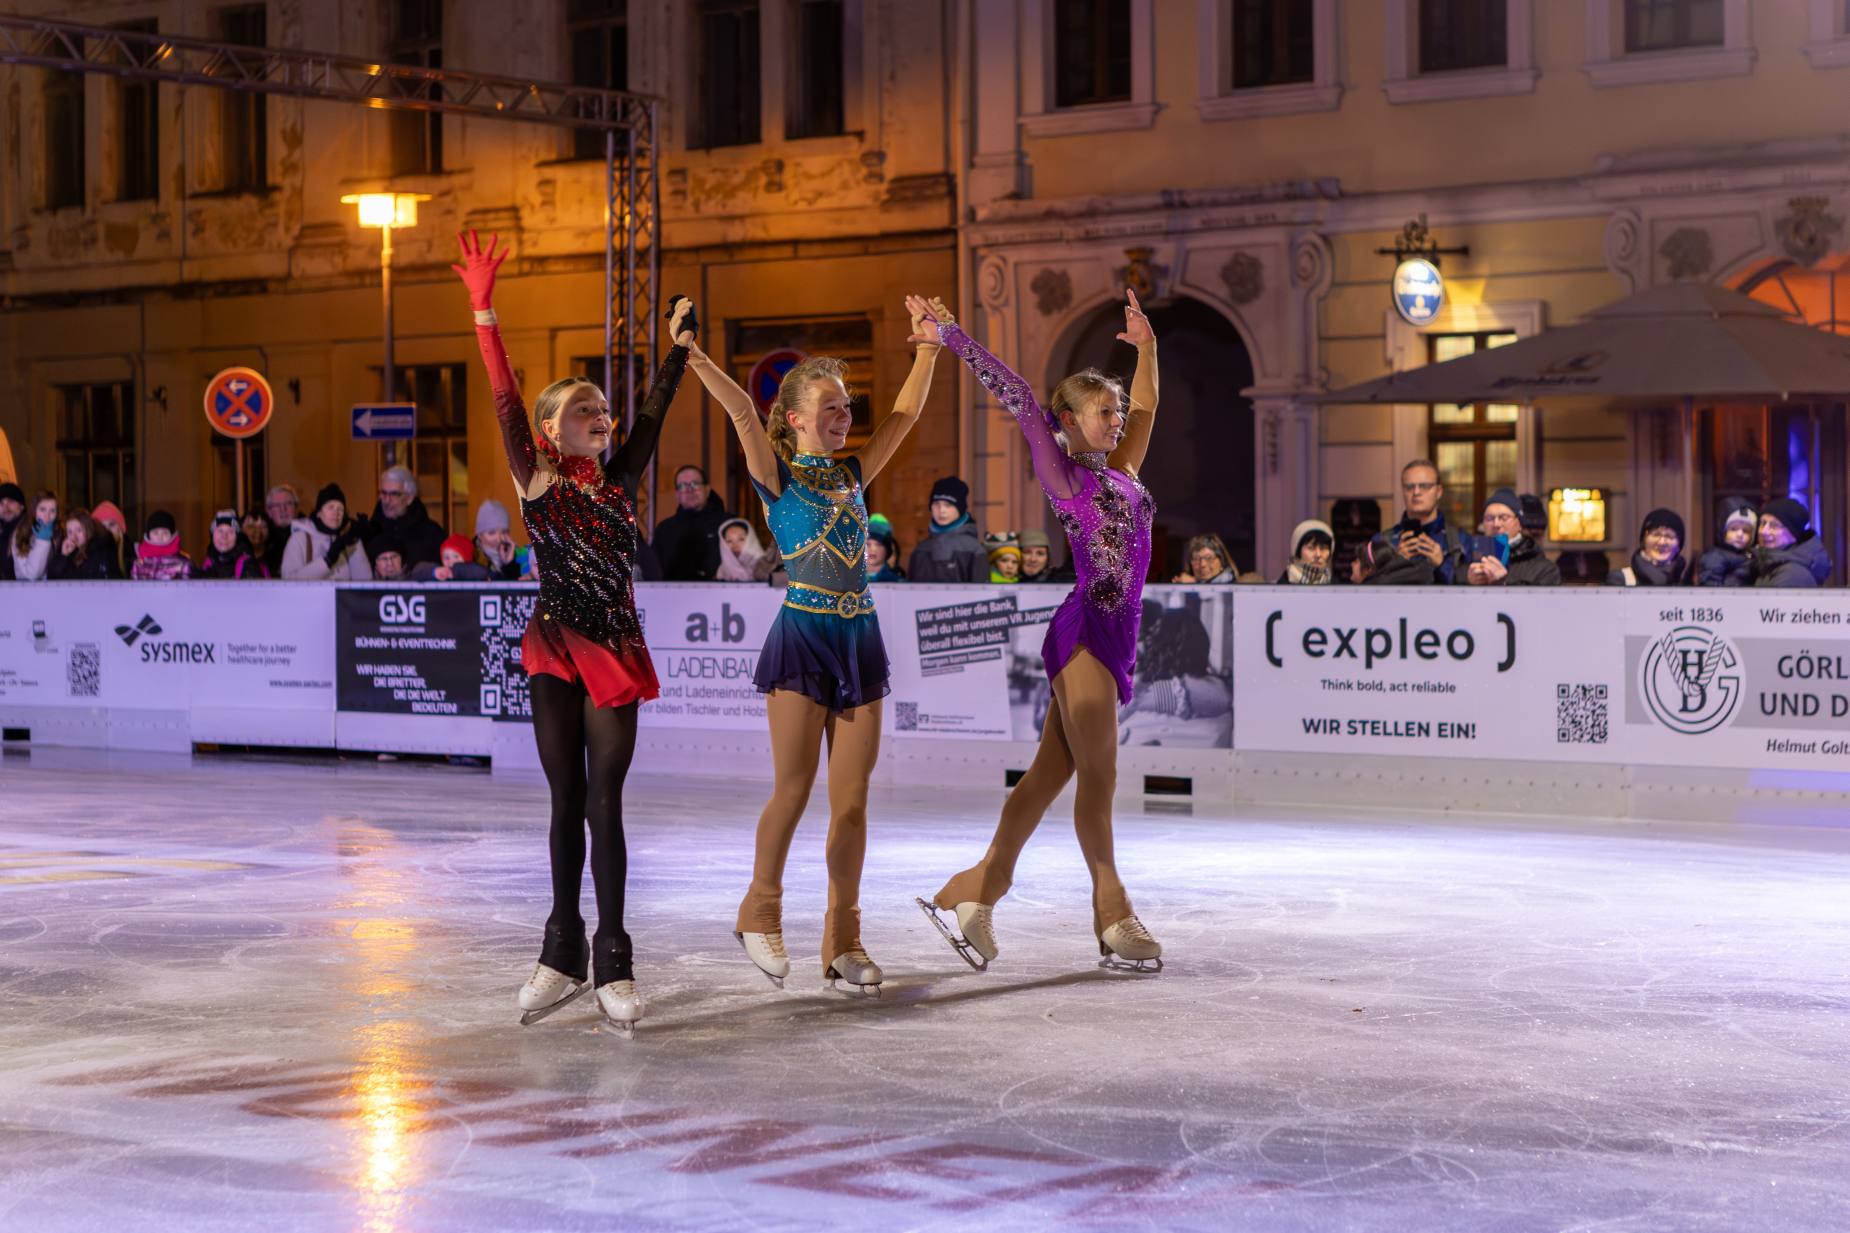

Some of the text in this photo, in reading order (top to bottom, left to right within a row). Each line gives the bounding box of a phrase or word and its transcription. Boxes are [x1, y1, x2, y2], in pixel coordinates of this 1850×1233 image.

[918, 599, 1015, 623] Wir sind hier die Bank,
[1659, 607, 1724, 622] seit 1836
[1760, 608, 1786, 623] Wir
[1791, 608, 1841, 624] ziehen
[919, 624, 938, 637] weil
[940, 622, 952, 635] du
[953, 620, 969, 632] mit
[970, 616, 1009, 630] unserem
[1009, 612, 1023, 624] VR
[227, 643, 257, 655] Together
[258, 644, 269, 653] for
[275, 644, 297, 653] better
[920, 637, 951, 652] überall
[952, 632, 985, 648] flexibel
[1302, 617, 1475, 670] expleo
[141, 640, 215, 665] sysmex
[1777, 649, 1849, 679] GÖRL
[662, 686, 682, 698] und
[1320, 679, 1456, 693] Think bold, act reliable
[655, 703, 683, 714] bilden
[686, 703, 720, 716] Tischler
[723, 705, 740, 716] und
[743, 705, 767, 717] Holz
[1760, 692, 1820, 717] UND
[1302, 718, 1476, 739] WIR STELLEN EIN!
[1766, 738, 1817, 754] Helmut
